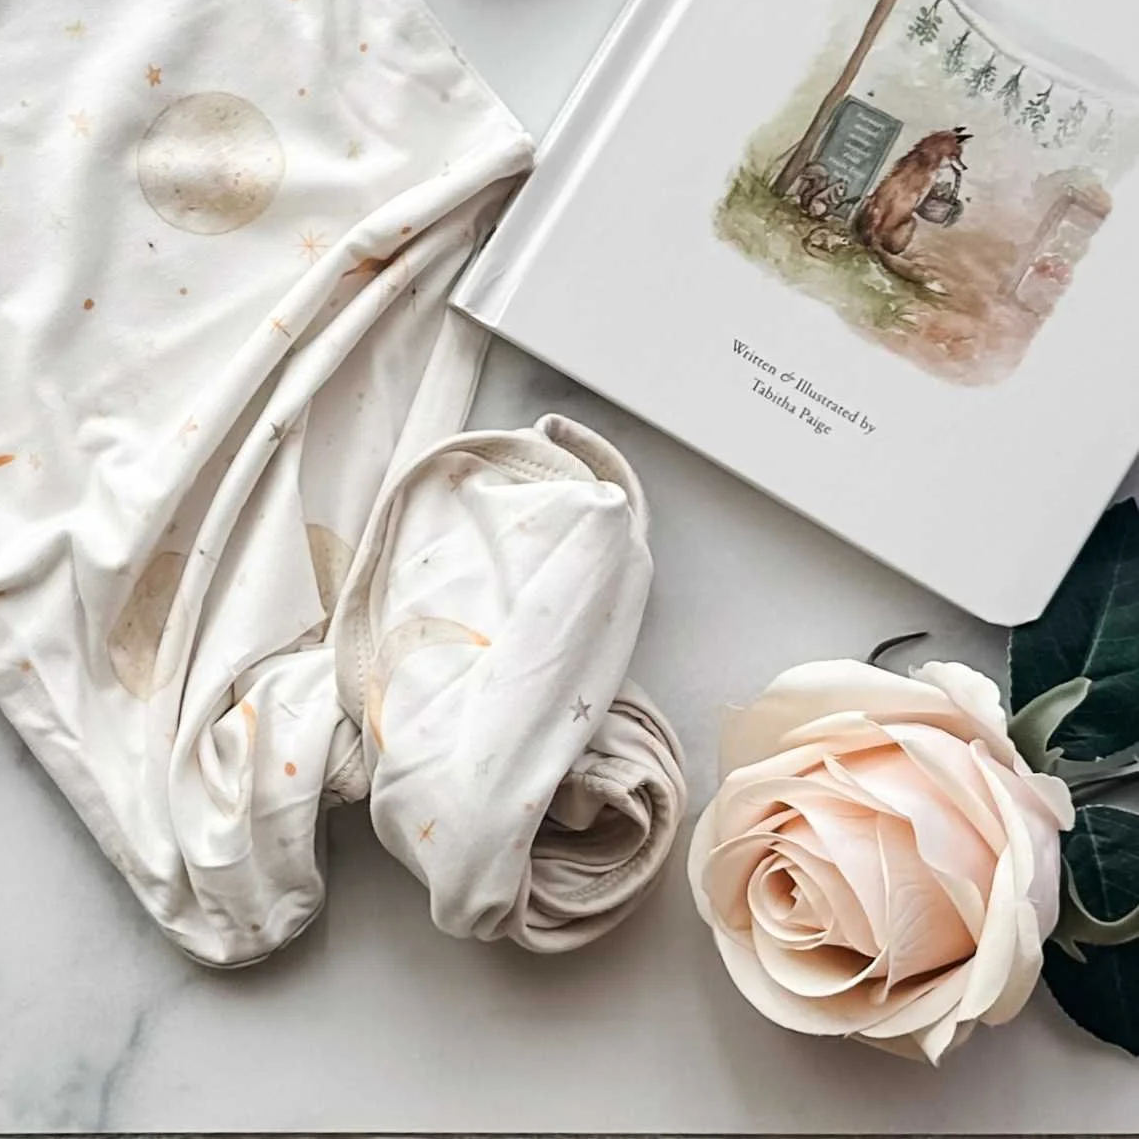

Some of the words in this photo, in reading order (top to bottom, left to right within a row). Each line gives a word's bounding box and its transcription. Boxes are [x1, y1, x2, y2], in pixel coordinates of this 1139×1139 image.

[732, 338, 777, 376] Written
[780, 371, 796, 383] &
[795, 378, 860, 423] Illustrated
[859, 415, 877, 435] by
[751, 377, 796, 415] Tabitha
[799, 407, 833, 435] Paige
